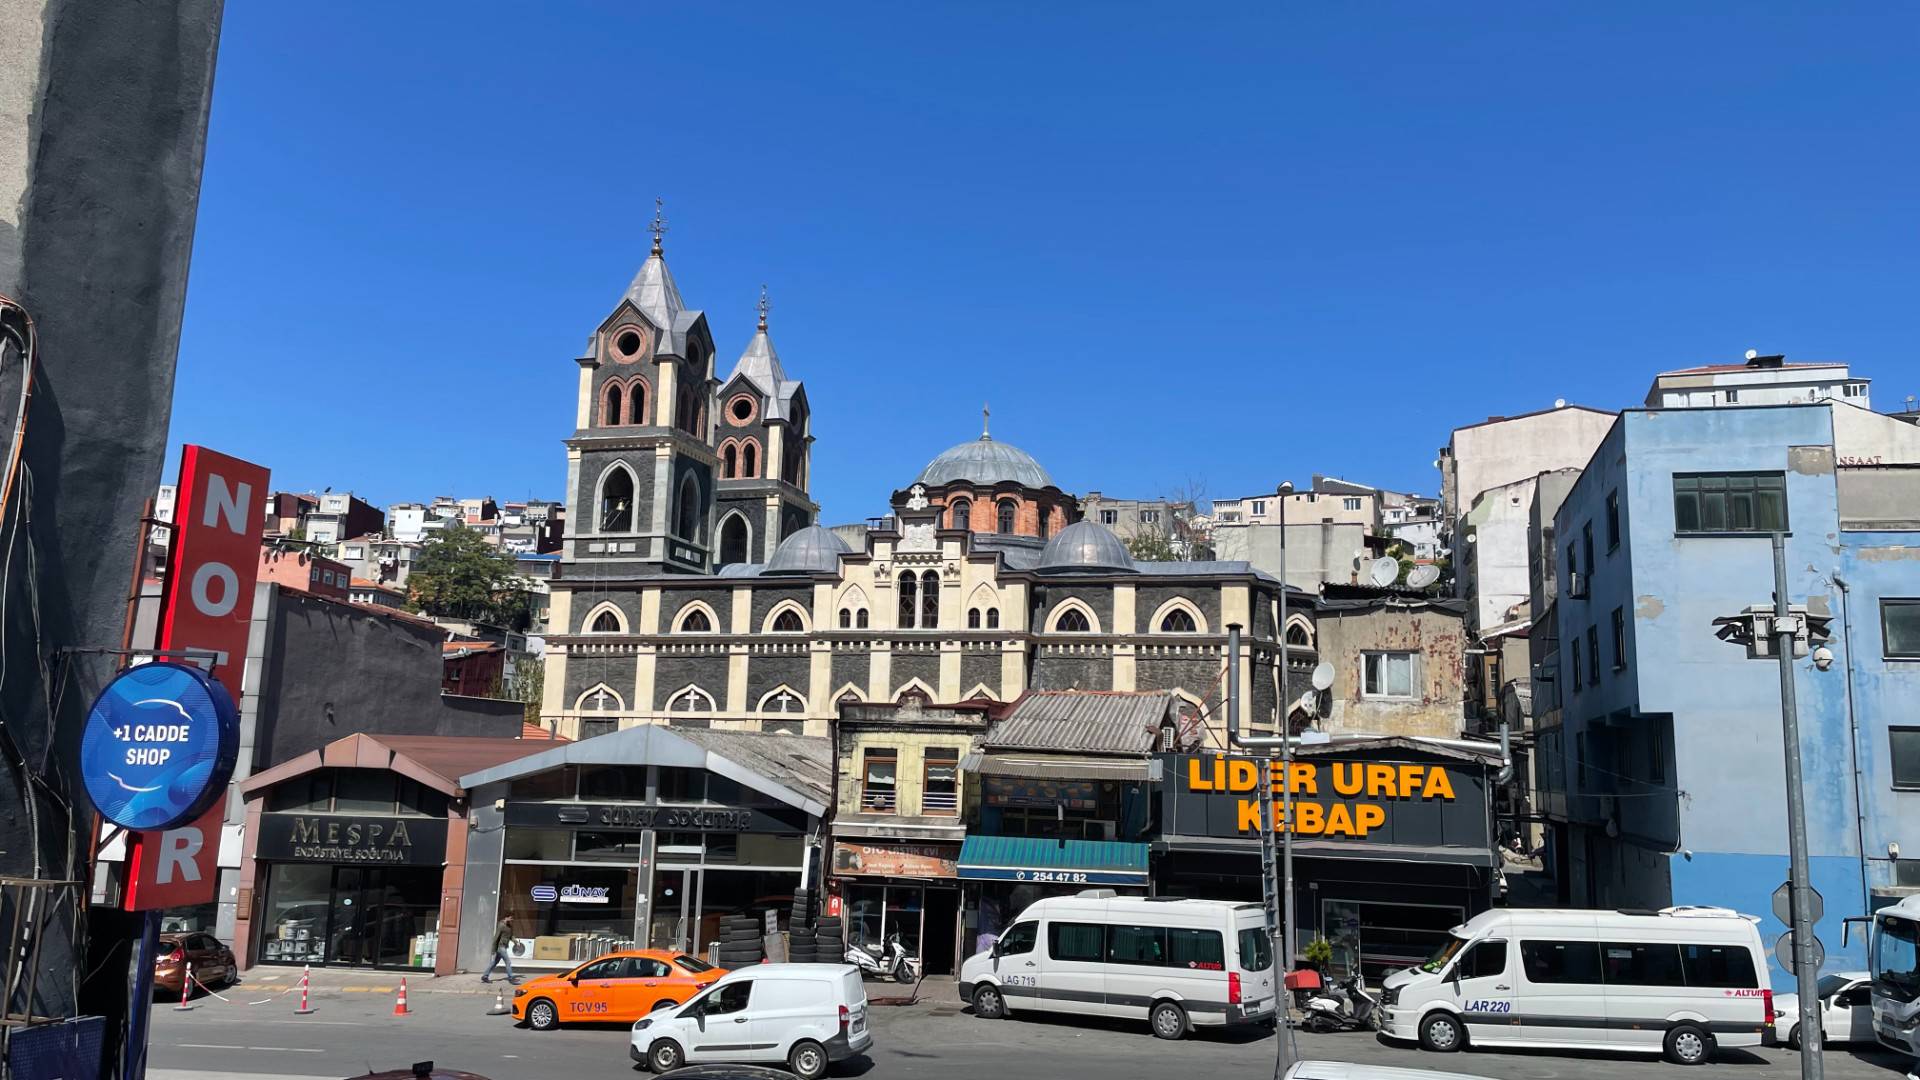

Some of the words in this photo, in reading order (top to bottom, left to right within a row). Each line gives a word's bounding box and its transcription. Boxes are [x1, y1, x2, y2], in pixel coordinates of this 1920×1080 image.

[113, 725, 131, 742] +1
[134, 725, 190, 742] CADDE
[126, 748, 170, 765] SHOP
[1189, 753, 1318, 794] LİDER
[1332, 763, 1456, 799] URFA
[1238, 800, 1386, 836] KEBAP
[289, 817, 412, 846] MESPA
[294, 846, 353, 859] ENDÜSTRİYEL
[355, 847, 404, 860] SOĞUTMA
[1033, 871, 1053, 881] 254
[1056, 872, 1070, 882] 47
[1072, 873, 1087, 883] 82
[561, 884, 609, 897] GÜNAY
[1001, 975, 1019, 985] LAG
[1022, 976, 1035, 986] 719
[570, 1002, 593, 1012] TCV
[594, 1002, 608, 1012] 95
[1464, 1000, 1489, 1011] LAR
[1490, 1001, 1510, 1012] 220
